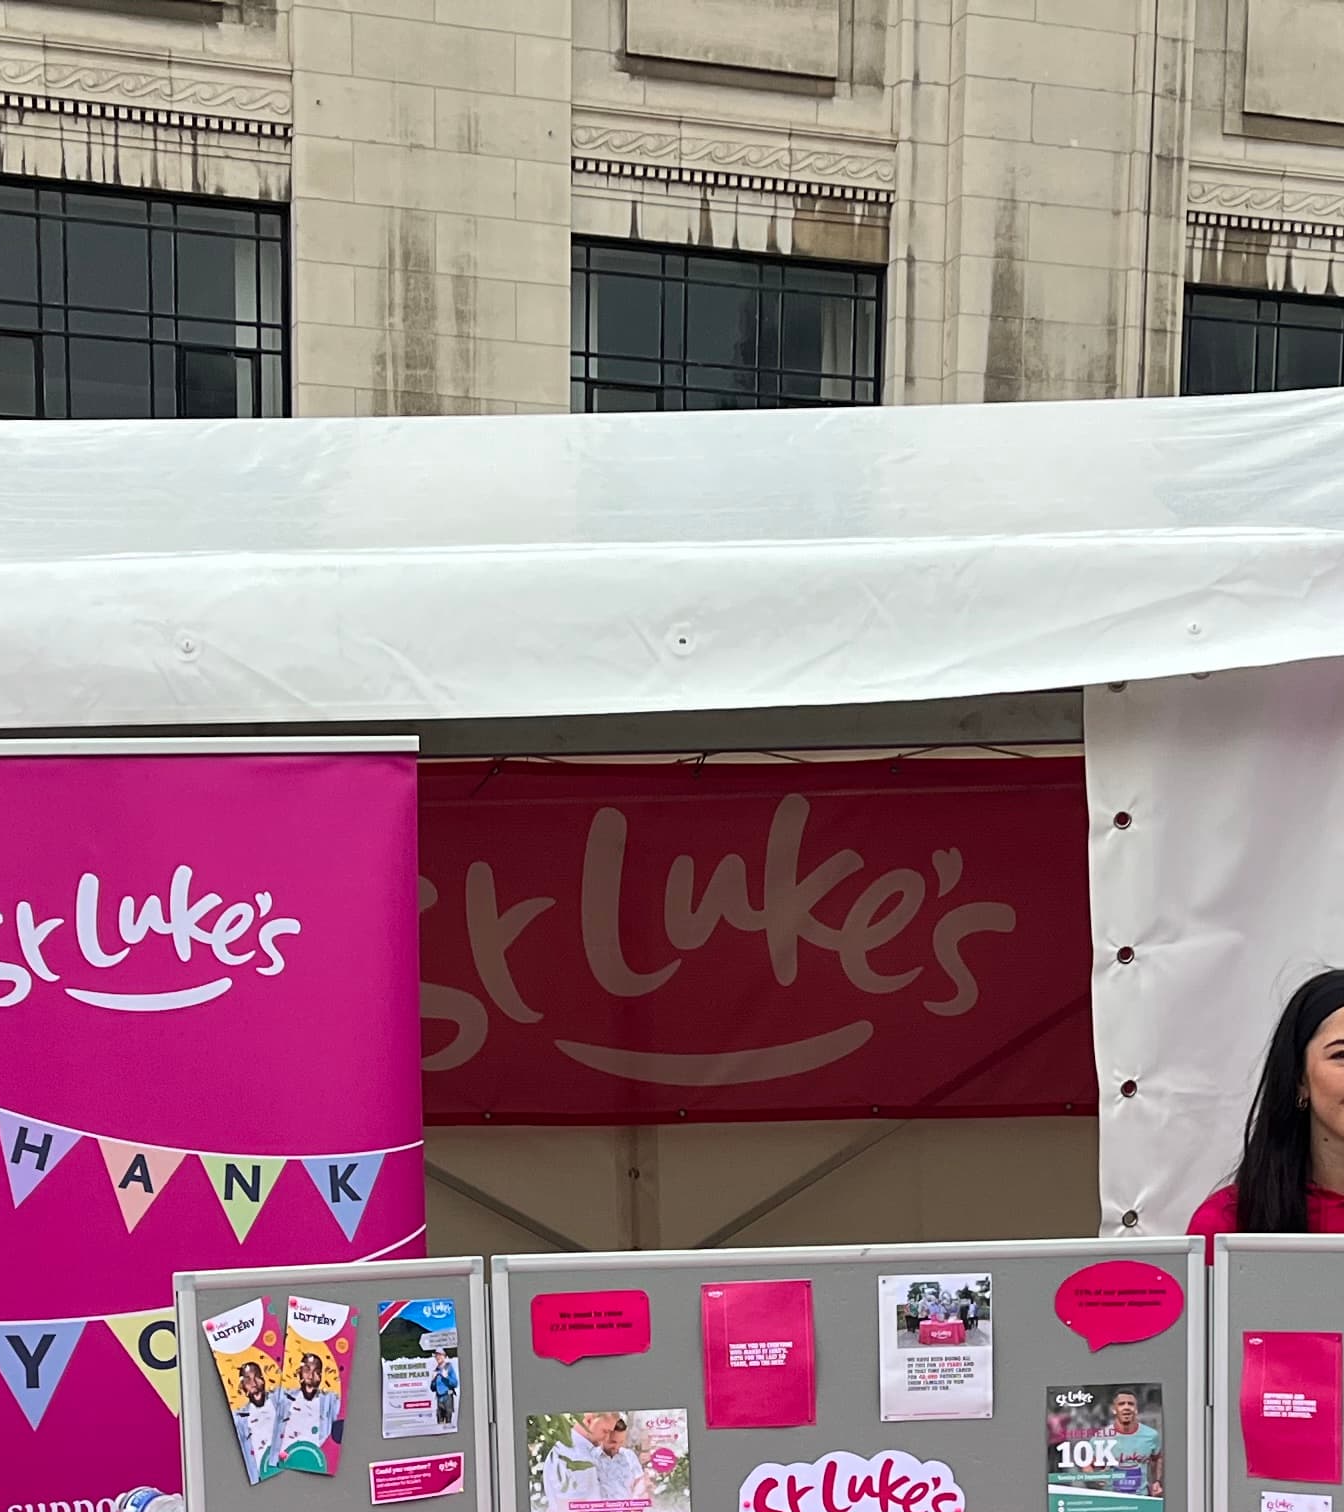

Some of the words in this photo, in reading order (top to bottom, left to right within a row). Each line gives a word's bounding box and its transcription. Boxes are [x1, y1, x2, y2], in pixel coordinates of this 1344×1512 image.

[581, 793, 1016, 1016] Luke's
[76, 865, 301, 976] Luke's
[212, 1317, 256, 1342] LOTTERY
[293, 1311, 337, 1327] LOTTERY
[1056, 1440, 1120, 1468] 10K
